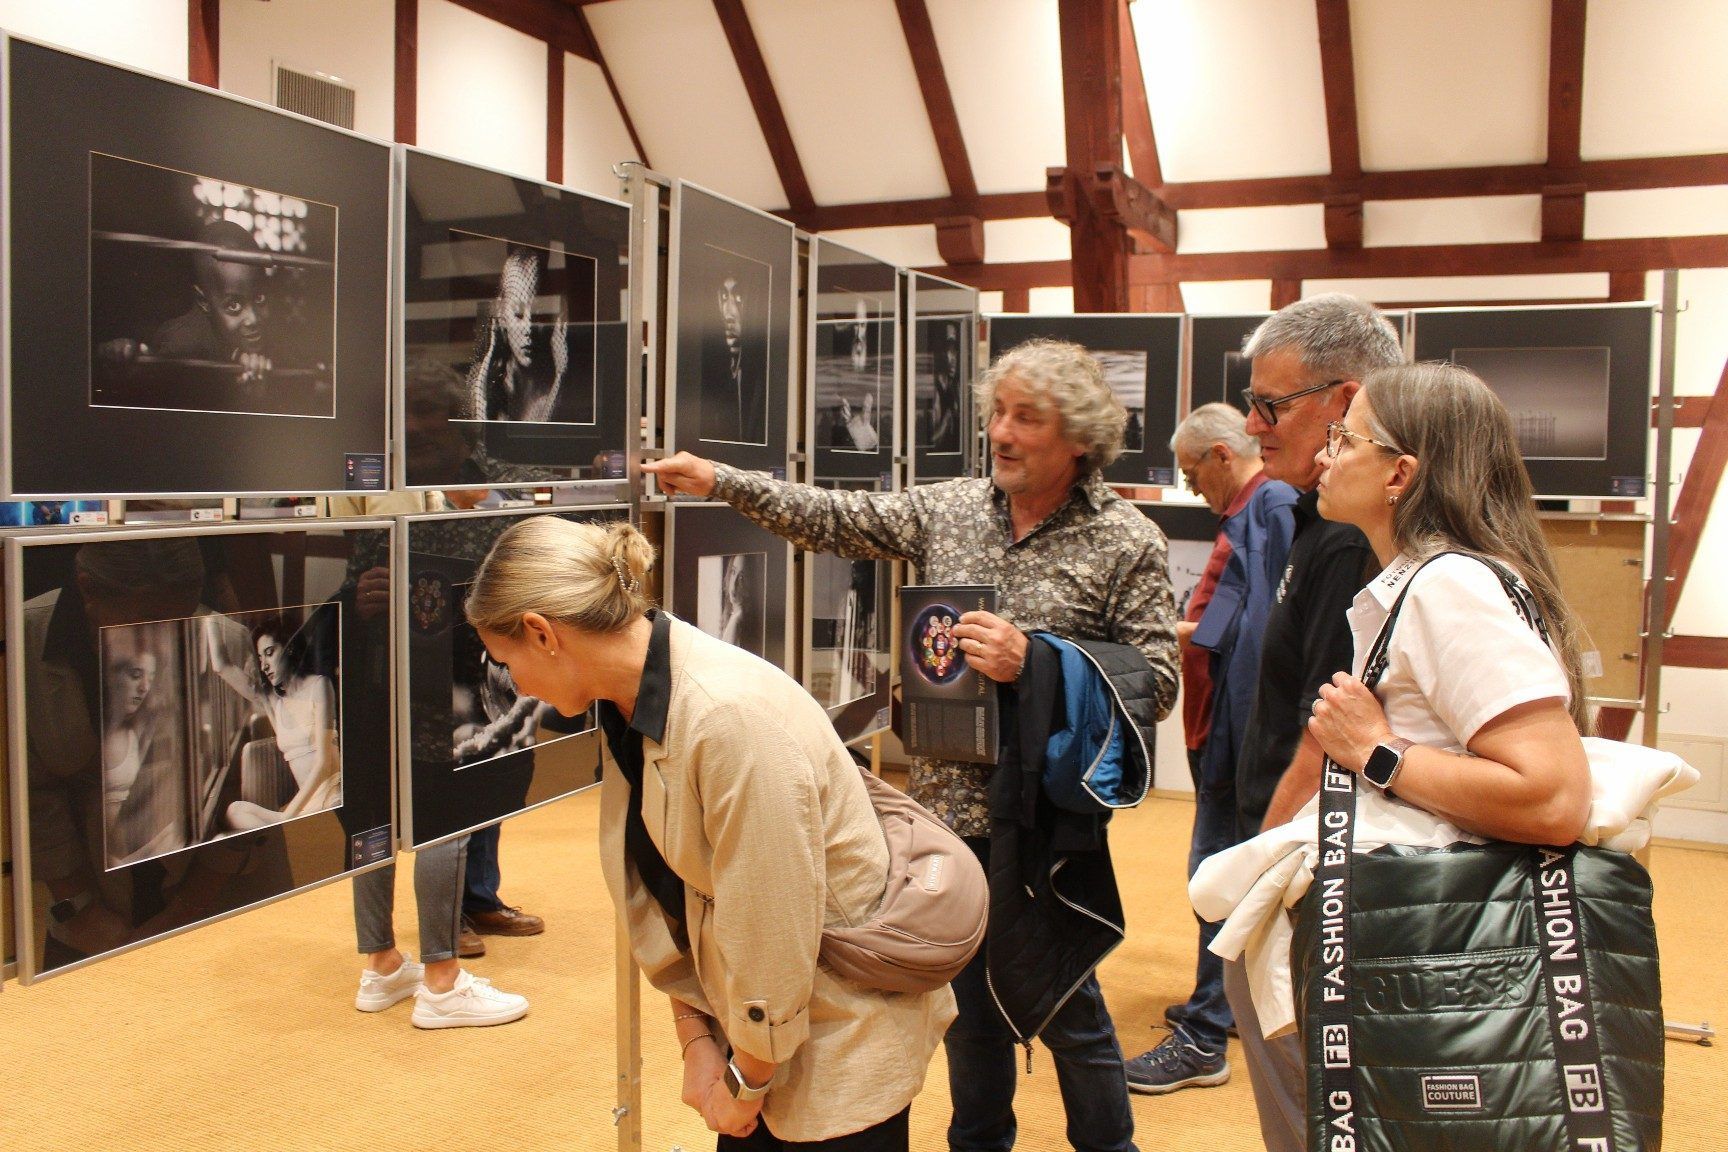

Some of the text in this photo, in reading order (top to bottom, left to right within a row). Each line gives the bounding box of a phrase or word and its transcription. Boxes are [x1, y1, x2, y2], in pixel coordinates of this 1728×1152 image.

[1324, 811, 1349, 866] BAG
[1539, 848, 1578, 960] ASHION
[1322, 878, 1345, 1002] FASHION
[1553, 975, 1588, 1040] BAG
[1325, 1026, 1349, 1066] FB
[1427, 1083, 1474, 1091] FASHION BAG
[1428, 1091, 1475, 1100] COUTURE
[1565, 1065, 1602, 1109] FB
[1329, 1091, 1355, 1152] BAG
